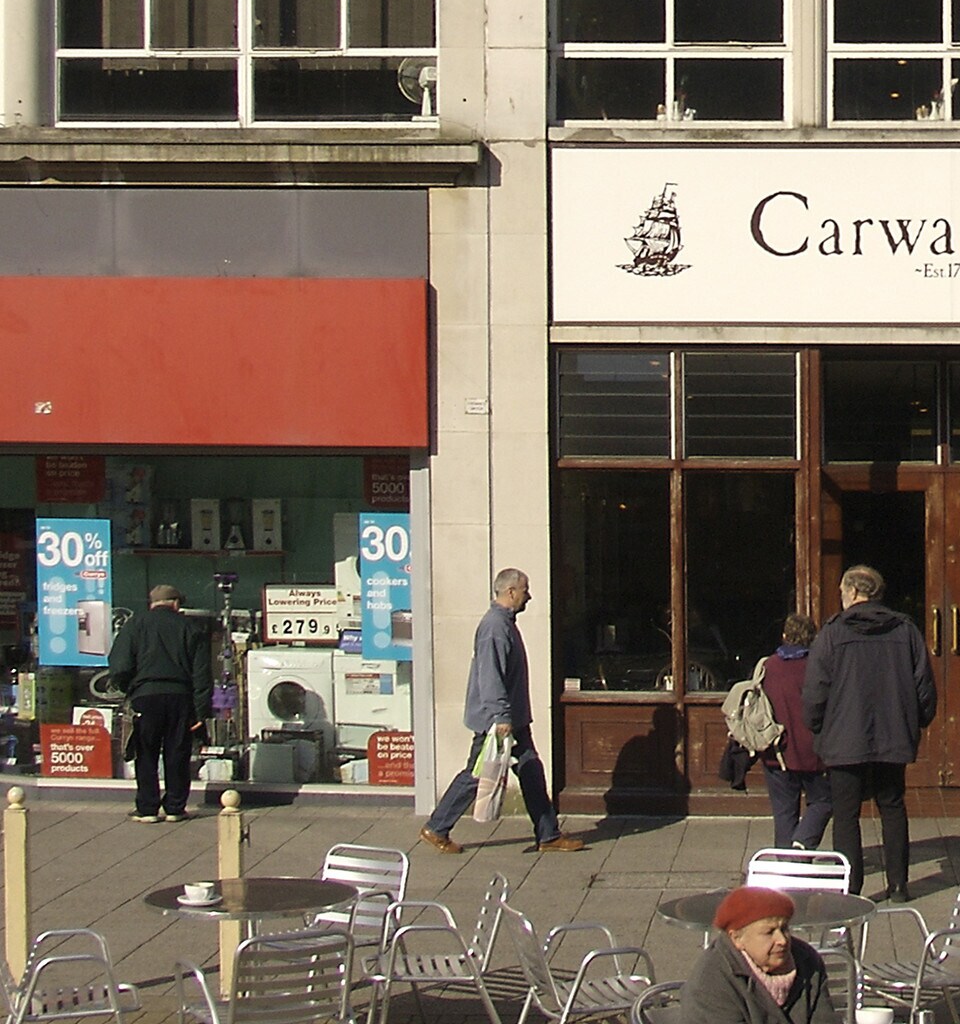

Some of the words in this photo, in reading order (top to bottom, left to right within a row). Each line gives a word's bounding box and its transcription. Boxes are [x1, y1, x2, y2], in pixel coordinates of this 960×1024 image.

[371, 482, 405, 494] 5000
[84, 550, 108, 566] off
[366, 576, 408, 586] cookers
[43, 582, 78, 593] fridges
[289, 590, 321, 598] Always
[366, 589, 386, 598] and
[43, 595, 63, 603] and
[268, 598, 311, 606] Lowering
[366, 600, 392, 610] hobs
[43, 606, 86, 616] freezers
[50, 752, 84, 764] 5000
[390, 752, 412, 760] price
[51, 765, 89, 774] products
